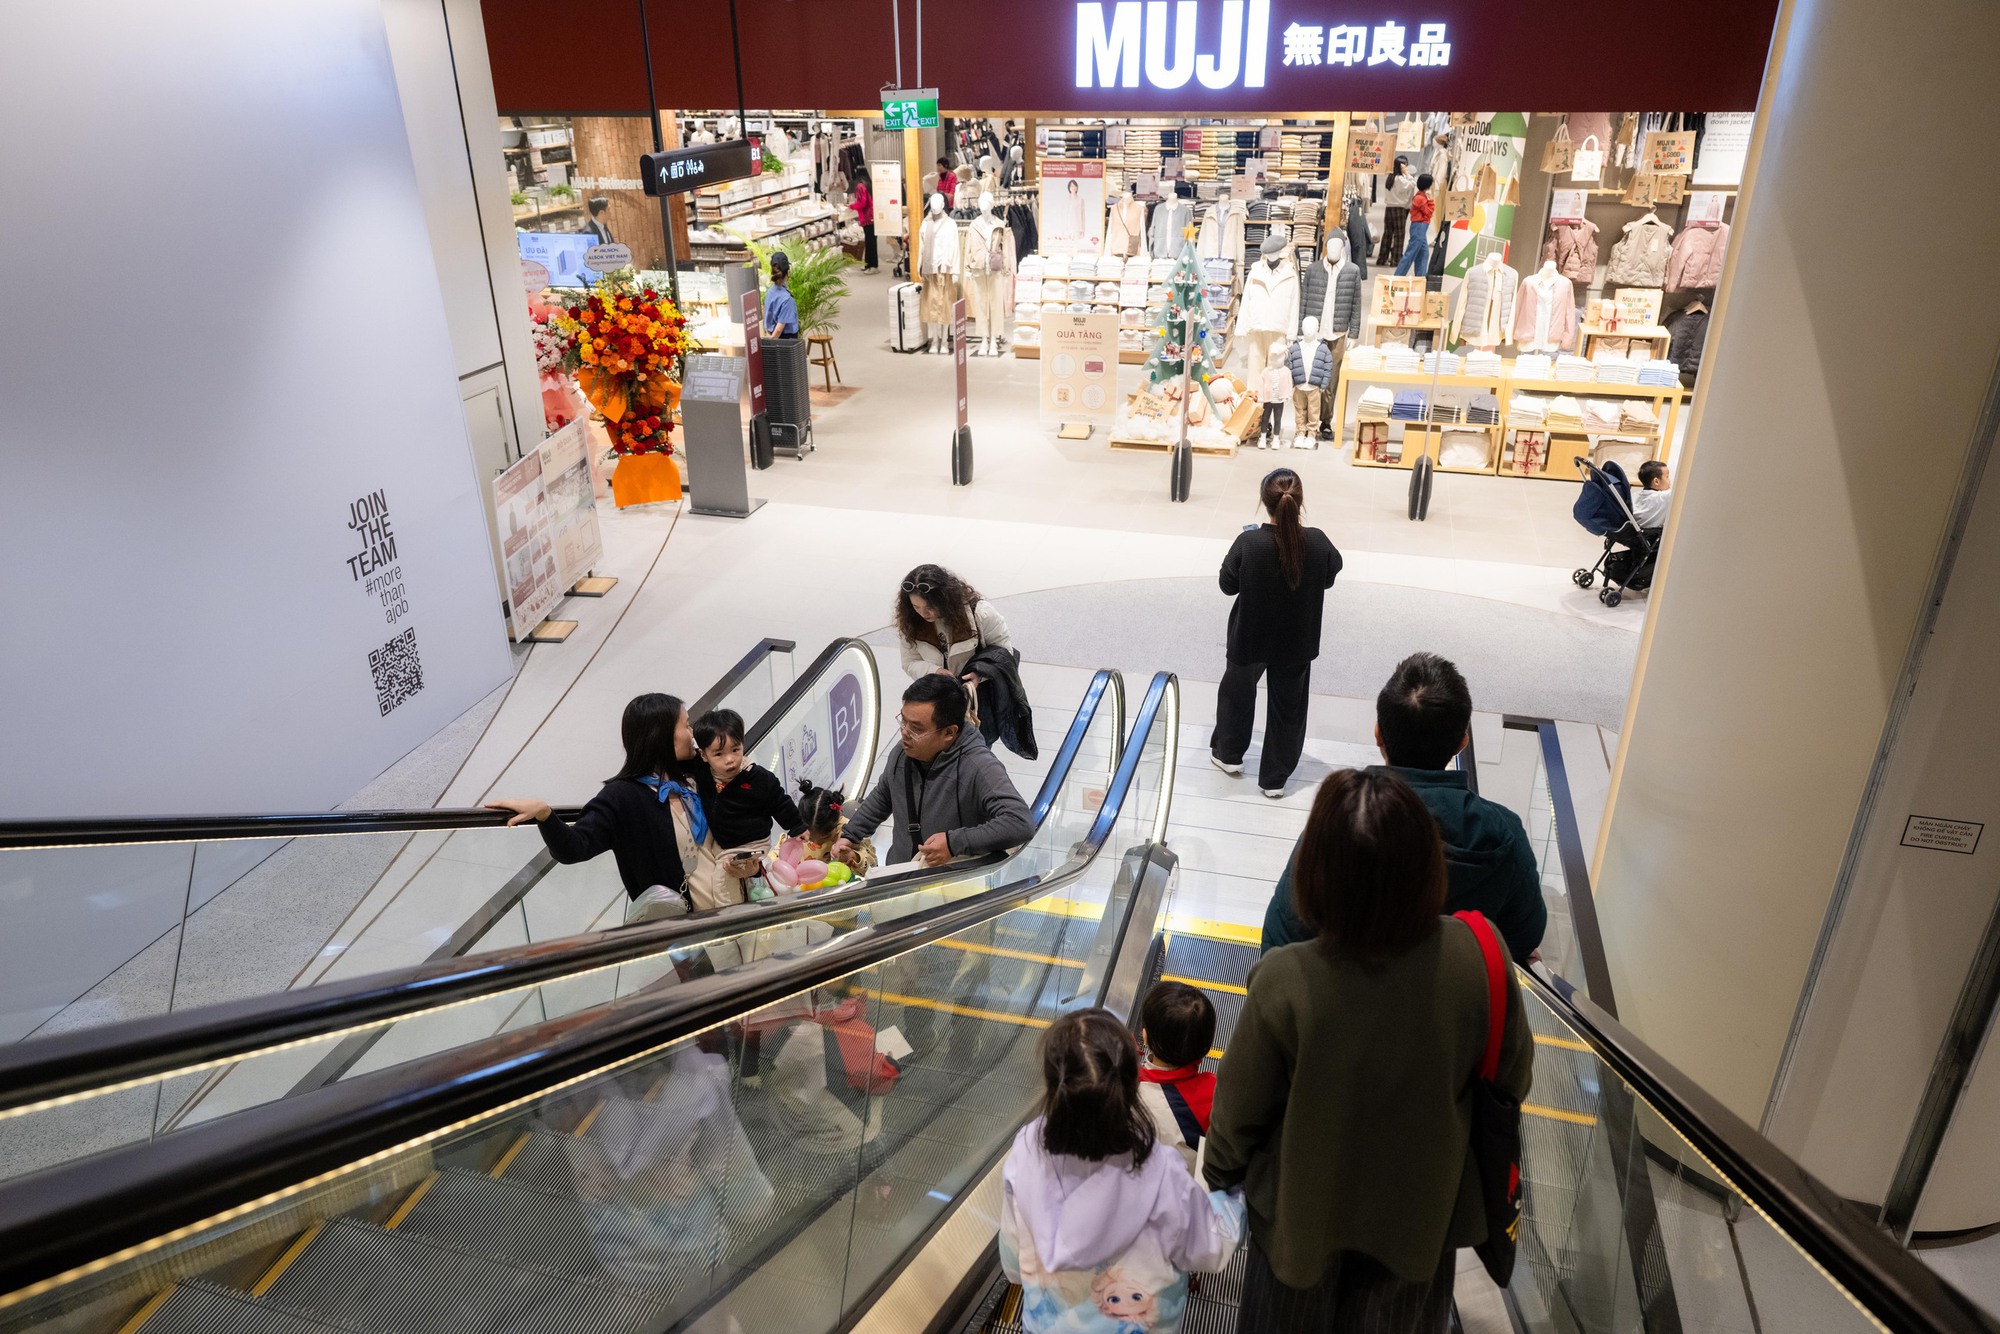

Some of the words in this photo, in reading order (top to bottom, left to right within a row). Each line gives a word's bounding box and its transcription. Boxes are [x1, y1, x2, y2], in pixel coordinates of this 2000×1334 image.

[1076, 0, 1270, 89] MUJI
[1282, 21, 1451, 67] 無印良品
[885, 119, 901, 127] EXIT
[920, 117, 936, 125] EXIT
[751, 147, 761, 160] B1
[1056, 330, 1076, 338] QUÀ
[348, 488, 388, 529] JOIN
[356, 512, 394, 549] THE
[346, 536, 398, 582] TEAM
[365, 565, 402, 597] #more
[380, 582, 406, 607] than
[385, 598, 409, 625] ajob
[835, 692, 861, 750] B1
[1934, 834, 1961, 842] CURTAIN
[1935, 840, 1968, 848] OBSTRUCT
